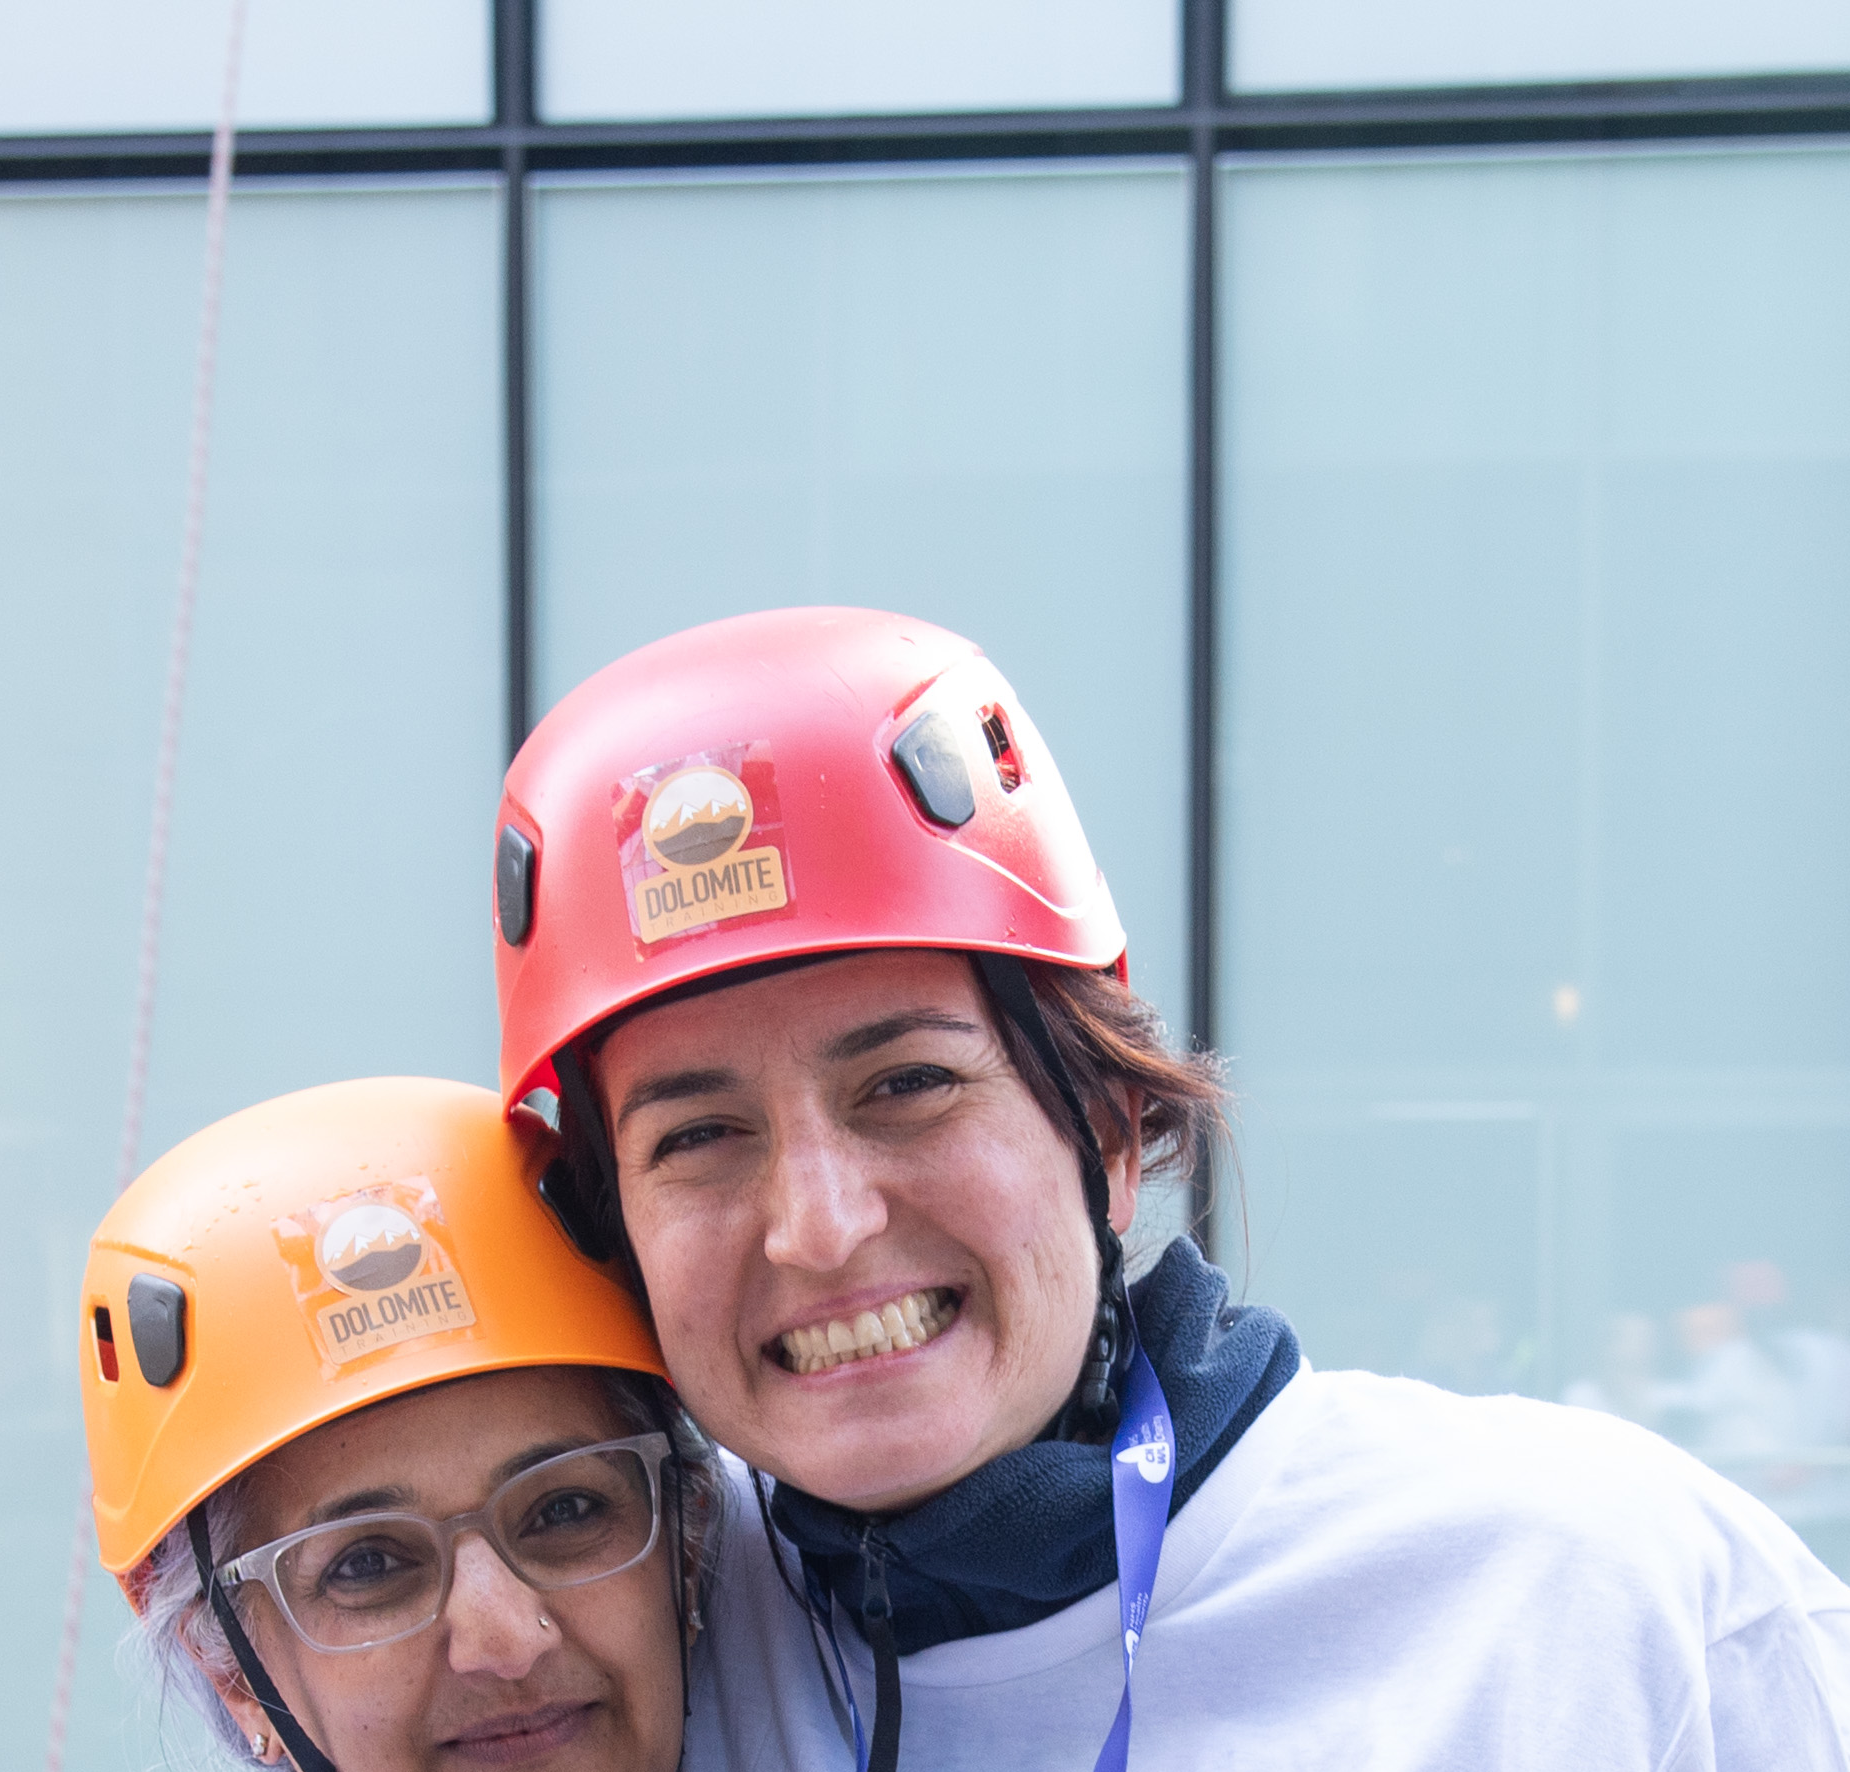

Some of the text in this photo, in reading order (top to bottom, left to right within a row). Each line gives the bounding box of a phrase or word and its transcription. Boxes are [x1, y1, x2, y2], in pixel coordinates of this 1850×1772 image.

[644, 856, 775, 921] DOLOMITE
[648, 890, 779, 931] TRAINING
[328, 1279, 462, 1345] DOLOMITE
[338, 1310, 468, 1357] TRAINING
